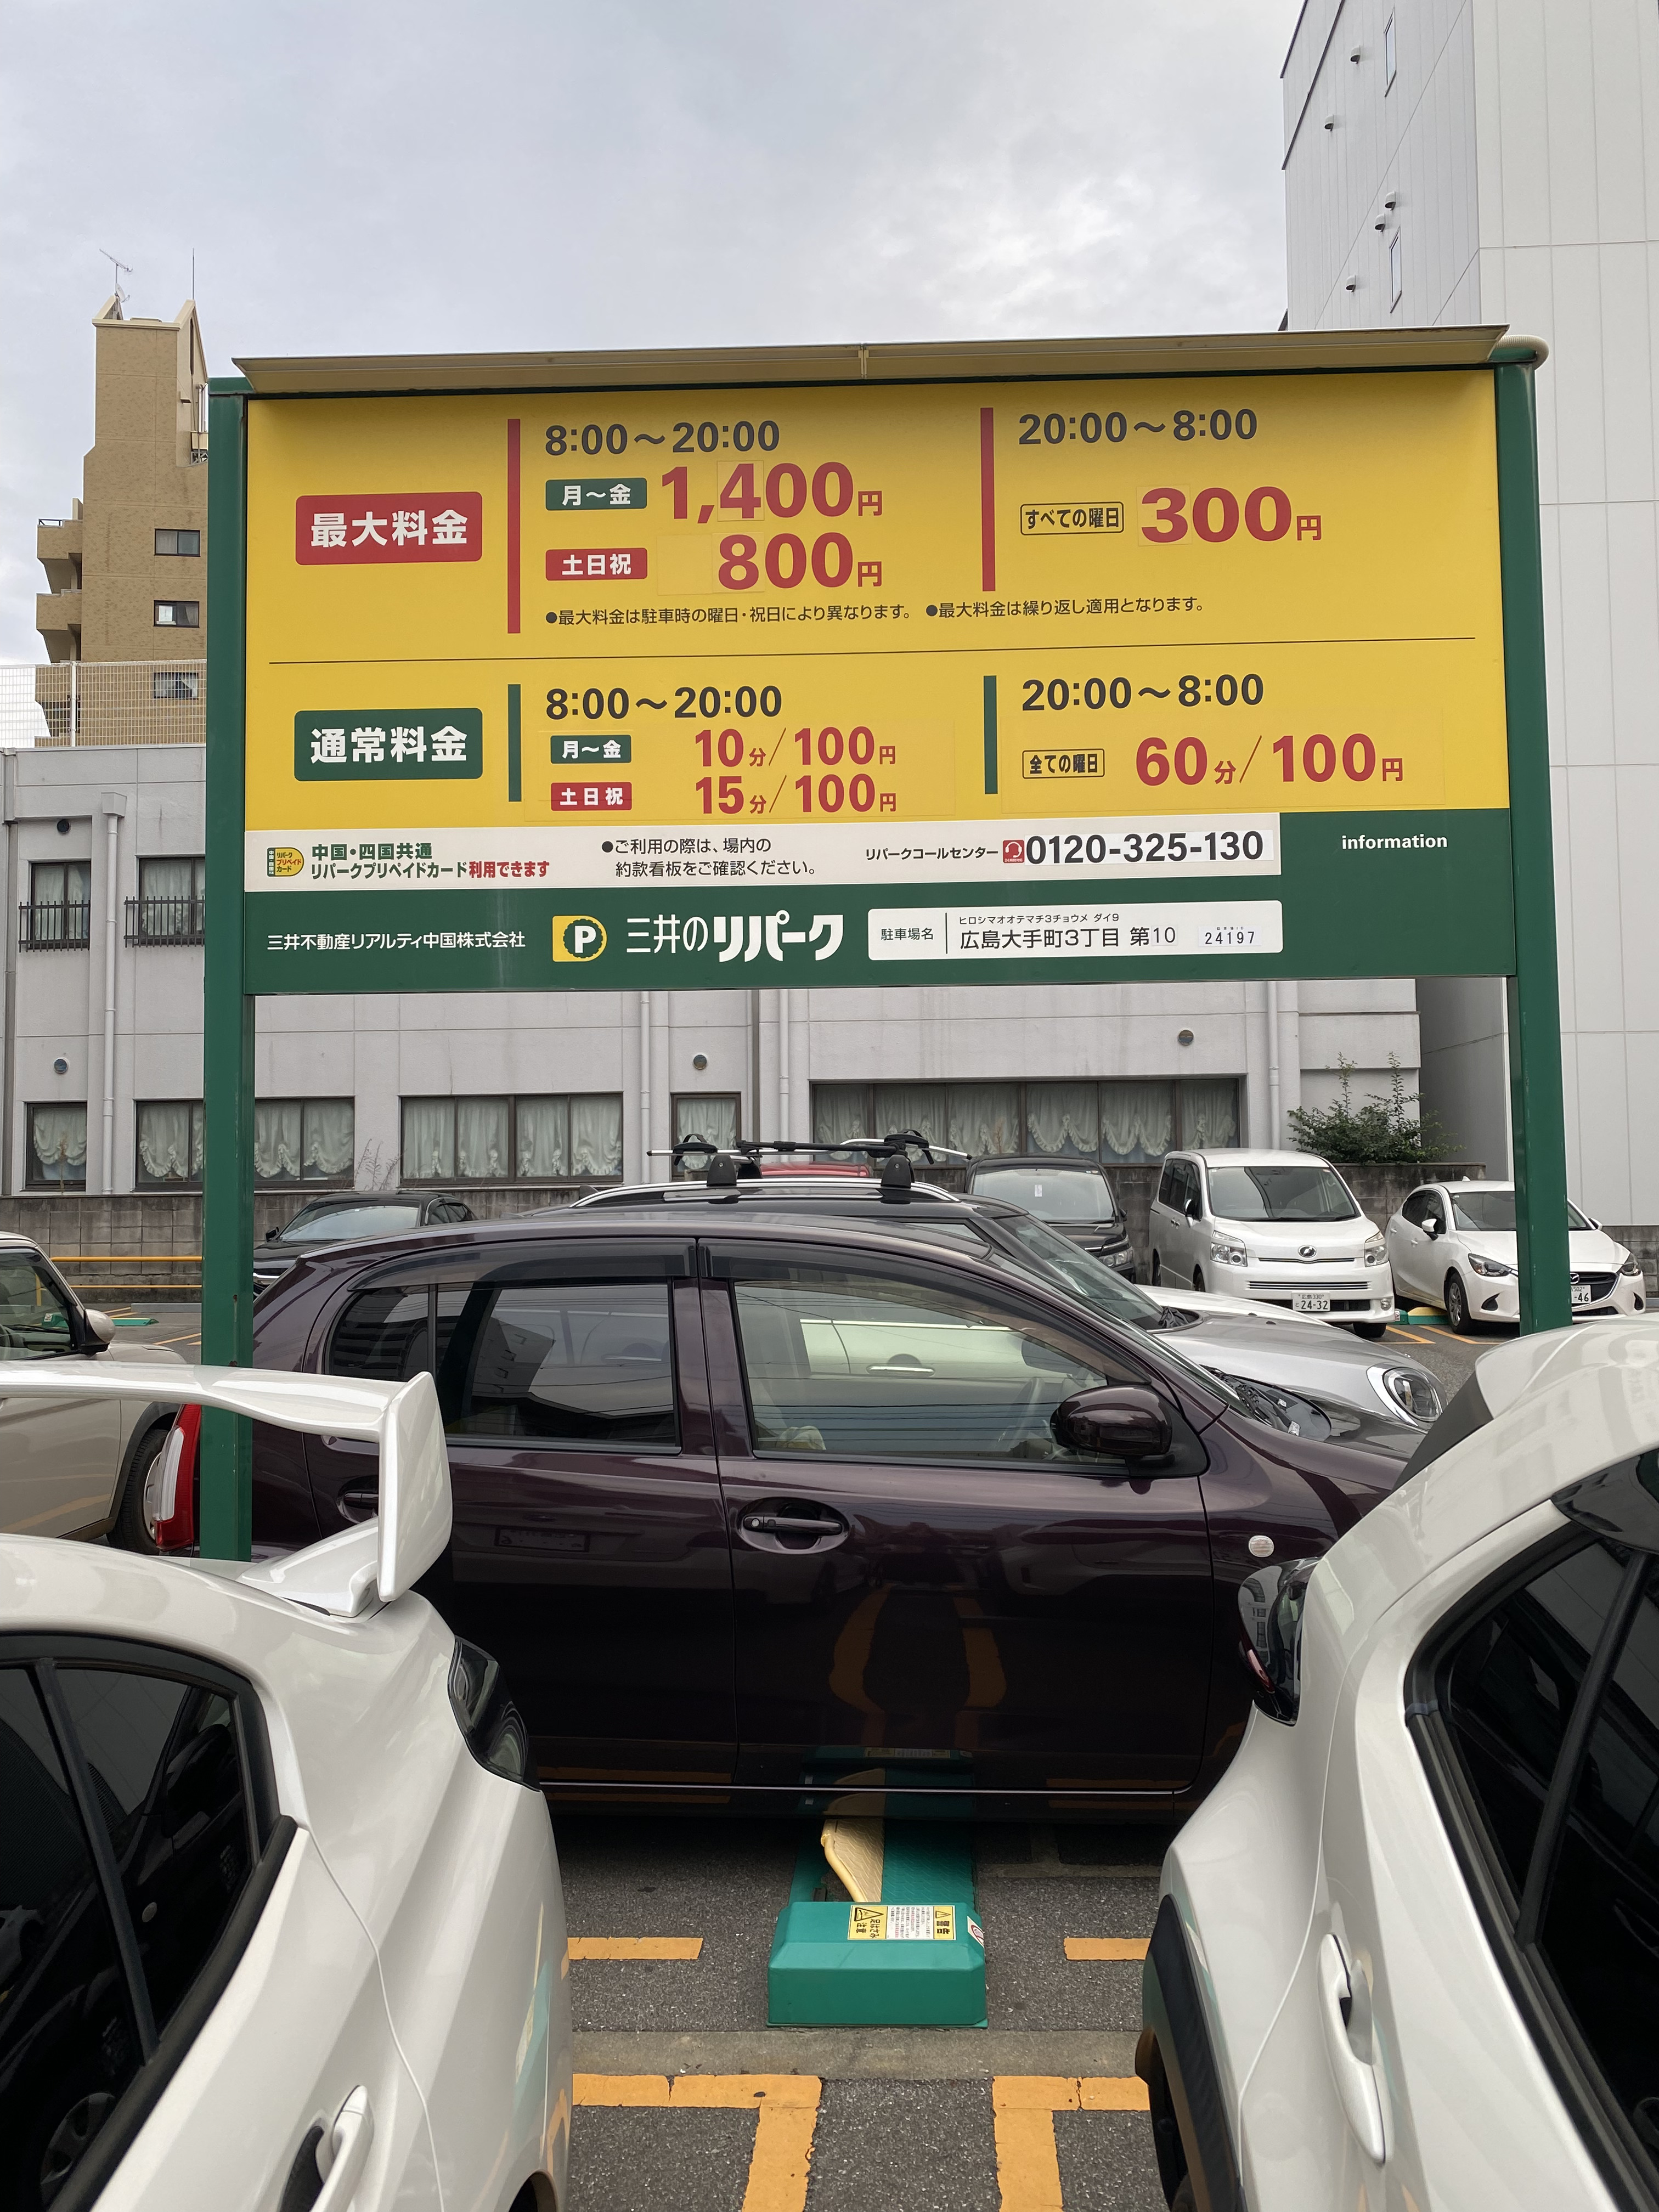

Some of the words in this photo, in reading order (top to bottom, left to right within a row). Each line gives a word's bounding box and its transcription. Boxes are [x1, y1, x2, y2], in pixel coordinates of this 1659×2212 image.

[662, 461, 883, 524] 1,400円
[1025, 507, 1119, 529] すべての曜日
[1142, 486, 1322, 543] 300円
[311, 509, 468, 548] 最大料金
[562, 554, 631, 575] 土日祝
[718, 532, 883, 590] 800円
[311, 725, 467, 764] 通常料金
[1030, 754, 1098, 774] 全ての曜日
[560, 787, 623, 805] 土日祝
[866, 847, 998, 861] リパークコールセンター
[1026, 831, 1263, 864] 0120-325-130
[1342, 833, 1447, 849] information
[312, 843, 432, 860] 中国・四国共通
[616, 860, 815, 878] 約款看板をご確認ください。
[960, 915, 1088, 924] ヒロシマオオテマチ3チョウメ
[1094, 913, 1119, 922] ダイ9
[267, 931, 526, 950] 三井不動産リアルティ中国株式会社
[627, 910, 843, 962] 三井のリパーク
[881, 927, 934, 941] 駐車場名
[960, 928, 1119, 950] 広島大手町3丁目
[1130, 927, 1176, 946] 第10
[1205, 931, 1255, 944] 24197
[1301, 1300, 1328, 1310] 24-32
[1574, 1293, 1589, 1302] -46
